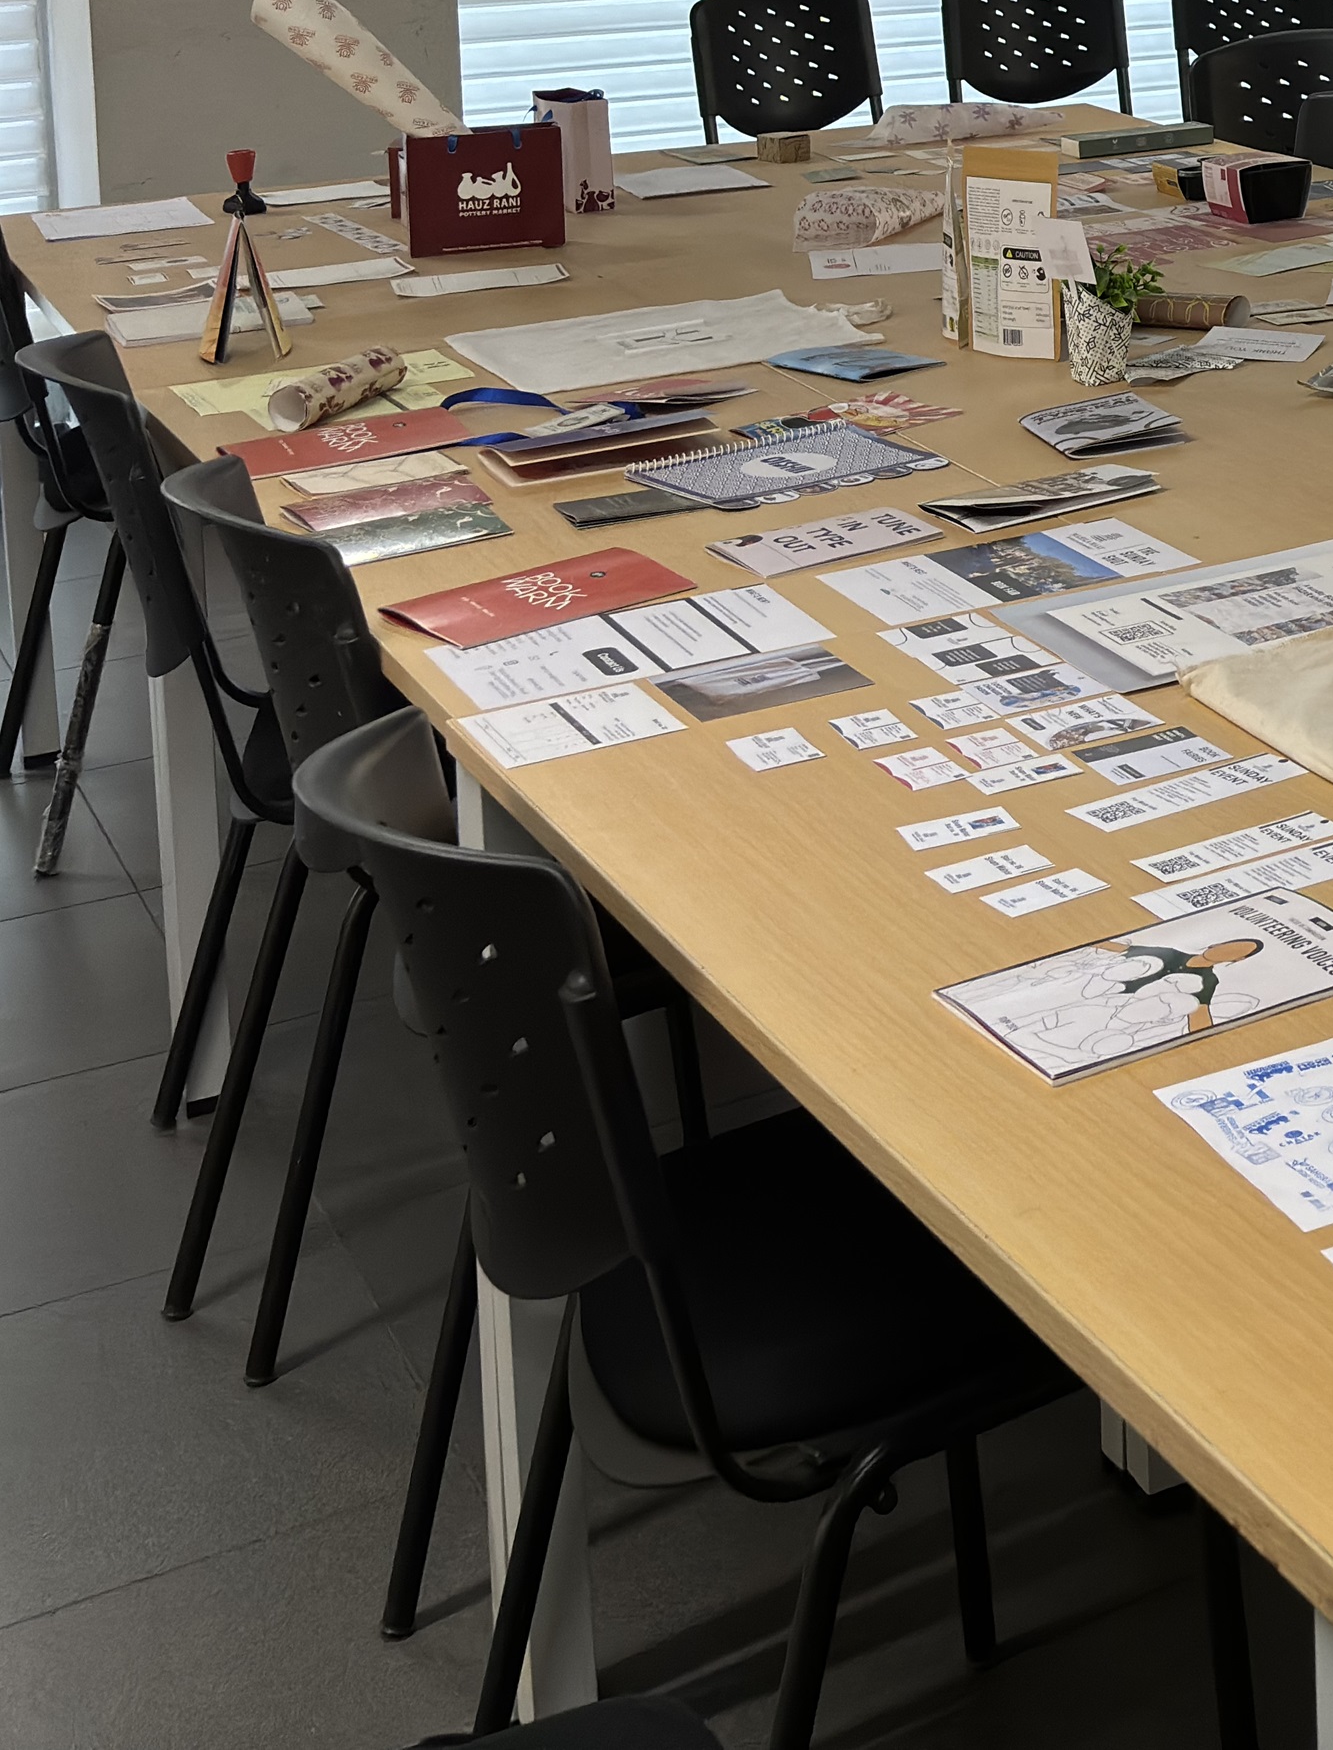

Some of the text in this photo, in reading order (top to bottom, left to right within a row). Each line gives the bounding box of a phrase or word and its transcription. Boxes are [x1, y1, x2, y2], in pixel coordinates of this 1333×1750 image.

[458, 197, 521, 211] HAUZ RANI
[1014, 250, 1039, 260] CAUTION
[837, 518, 866, 531] IN
[871, 512, 921, 536] TUNE
[773, 535, 816, 554] OUT
[806, 527, 854, 549] TYPE
[500, 575, 571, 610] WARM
[529, 571, 587, 601] BOOK
[1210, 769, 1248, 786] EVENT
[1228, 764, 1274, 783] SUNDAY
[1259, 827, 1292, 843] EVENT
[1276, 823, 1314, 841] SUNDAY
[1229, 904, 1313, 950] VOLUNTEERING
